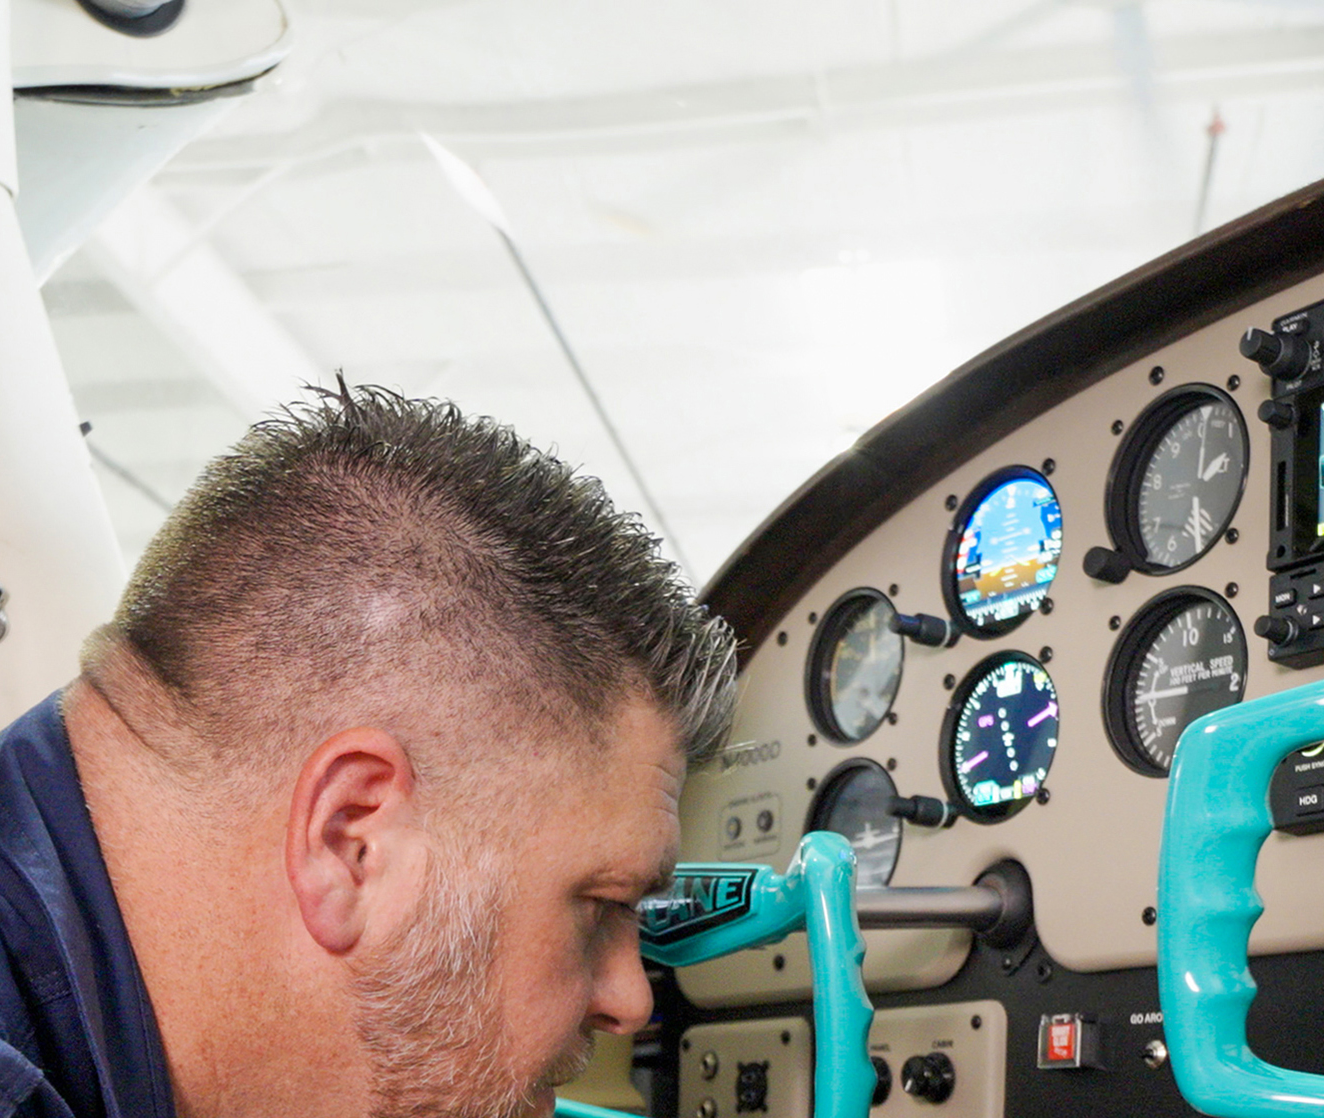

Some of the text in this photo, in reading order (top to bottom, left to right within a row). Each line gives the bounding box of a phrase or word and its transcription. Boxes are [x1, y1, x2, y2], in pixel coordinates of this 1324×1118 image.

[1170, 442, 1181, 459] 9
[1153, 473, 1162, 491] 8
[1152, 516, 1162, 534] 7
[1166, 535, 1177, 552] 6
[1275, 592, 1291, 602] MON
[1182, 627, 1199, 648] 10
[1170, 655, 1234, 678] VERTICAL SPEED
[1181, 668, 1211, 684] FEET PER
[1229, 672, 1239, 692] 2
[1295, 763, 1311, 773] PUSH
[1299, 794, 1318, 806] HDG
[1130, 1012, 1163, 1025] GO ARO
